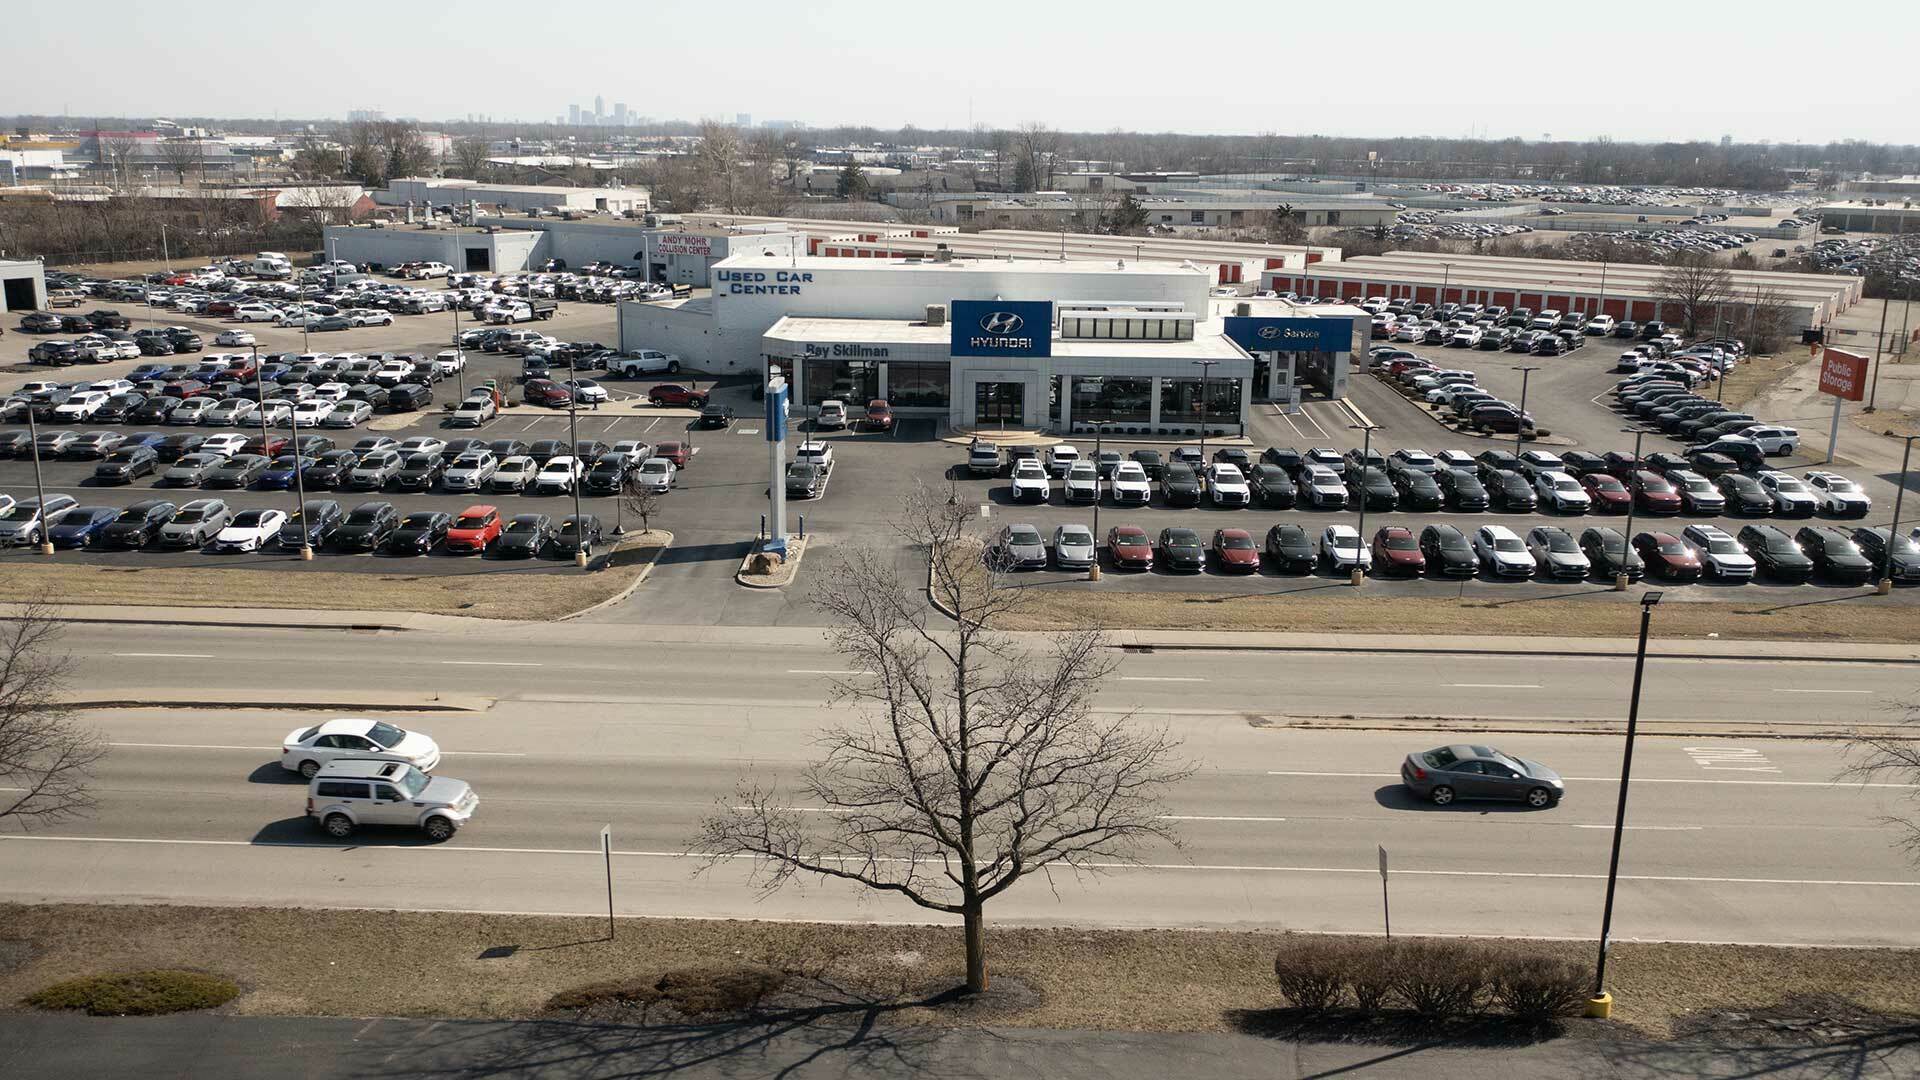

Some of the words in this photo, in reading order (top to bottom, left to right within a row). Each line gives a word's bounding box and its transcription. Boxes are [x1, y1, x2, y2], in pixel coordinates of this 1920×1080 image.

[662, 235, 682, 245] ANDY
[685, 236, 707, 246] MOHR
[657, 243, 688, 254] COLLISION
[689, 246, 711, 256] CENTER
[717, 270, 766, 282] USED
[776, 271, 813, 282] CAR
[730, 283, 801, 295] CENTER
[1283, 327, 1320, 338] Service
[970, 337, 1032, 348] HYUNDAI
[806, 343, 830, 358] Ray
[833, 344, 888, 357] Skillman
[1827, 359, 1853, 377] Public
[1822, 371, 1854, 392] Storage
